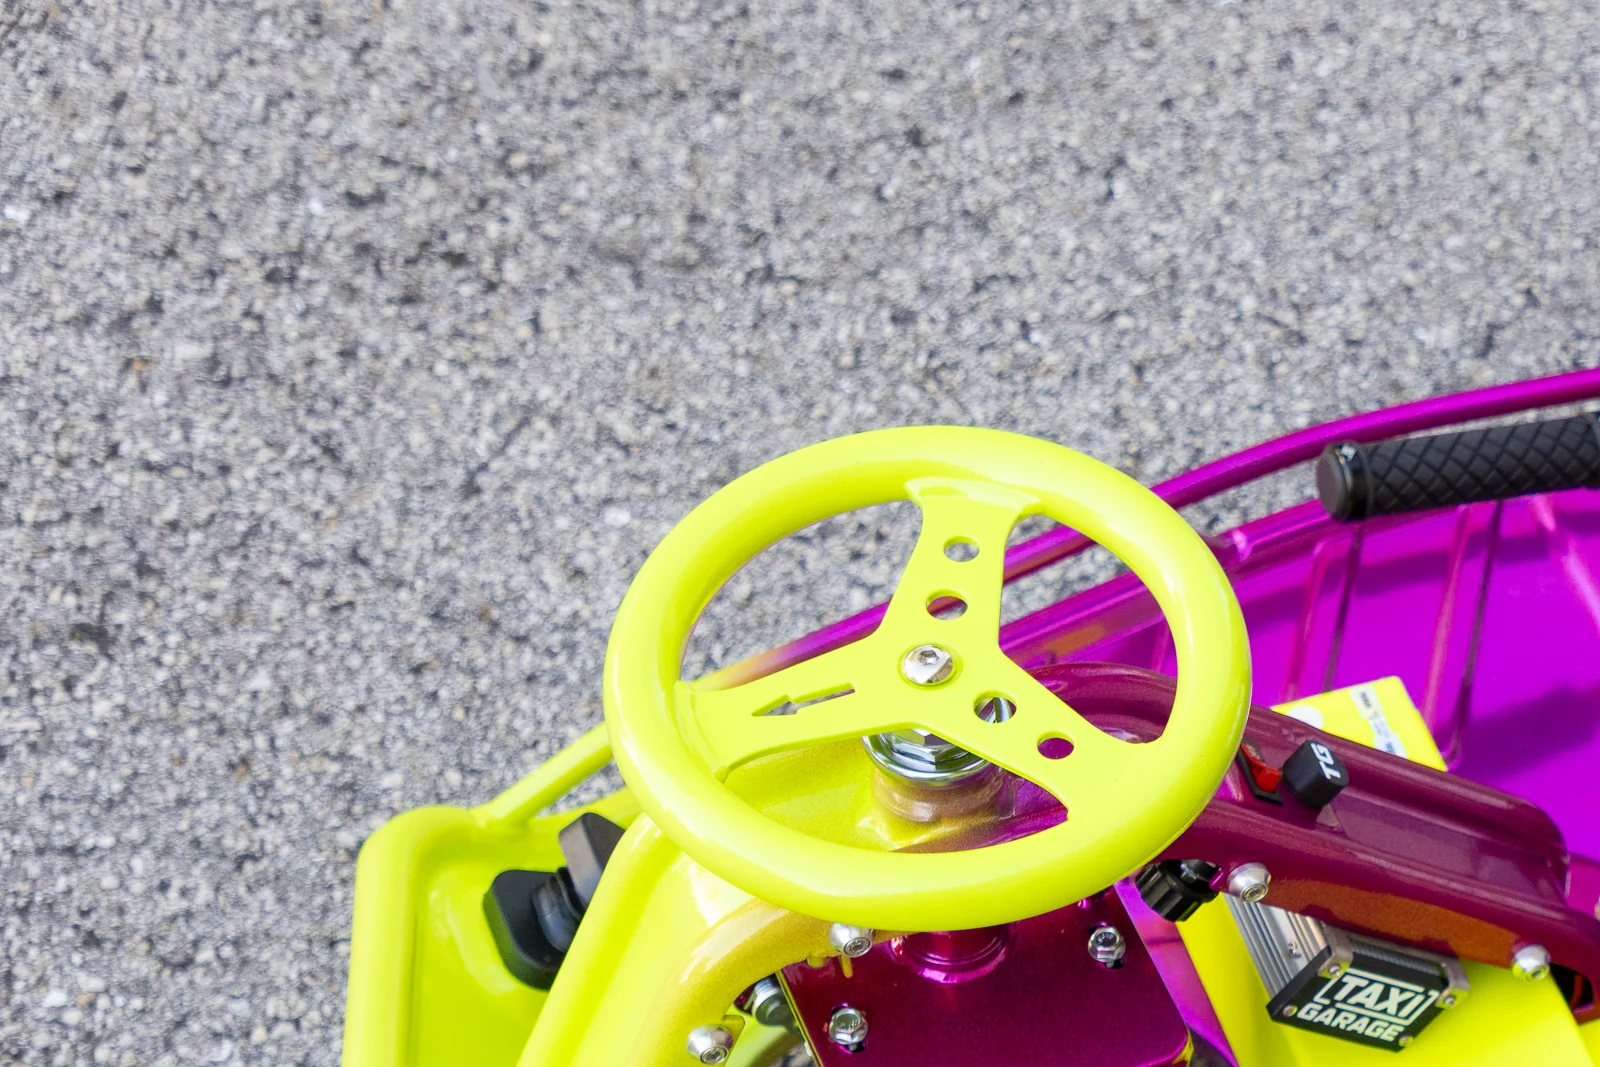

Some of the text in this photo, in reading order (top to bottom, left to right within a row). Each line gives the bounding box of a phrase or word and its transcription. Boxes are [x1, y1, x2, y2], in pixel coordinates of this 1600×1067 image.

[1310, 742, 1342, 780] TG
[1333, 974, 1425, 1019] TAXI
[1297, 1002, 1405, 1043] GARAGE
